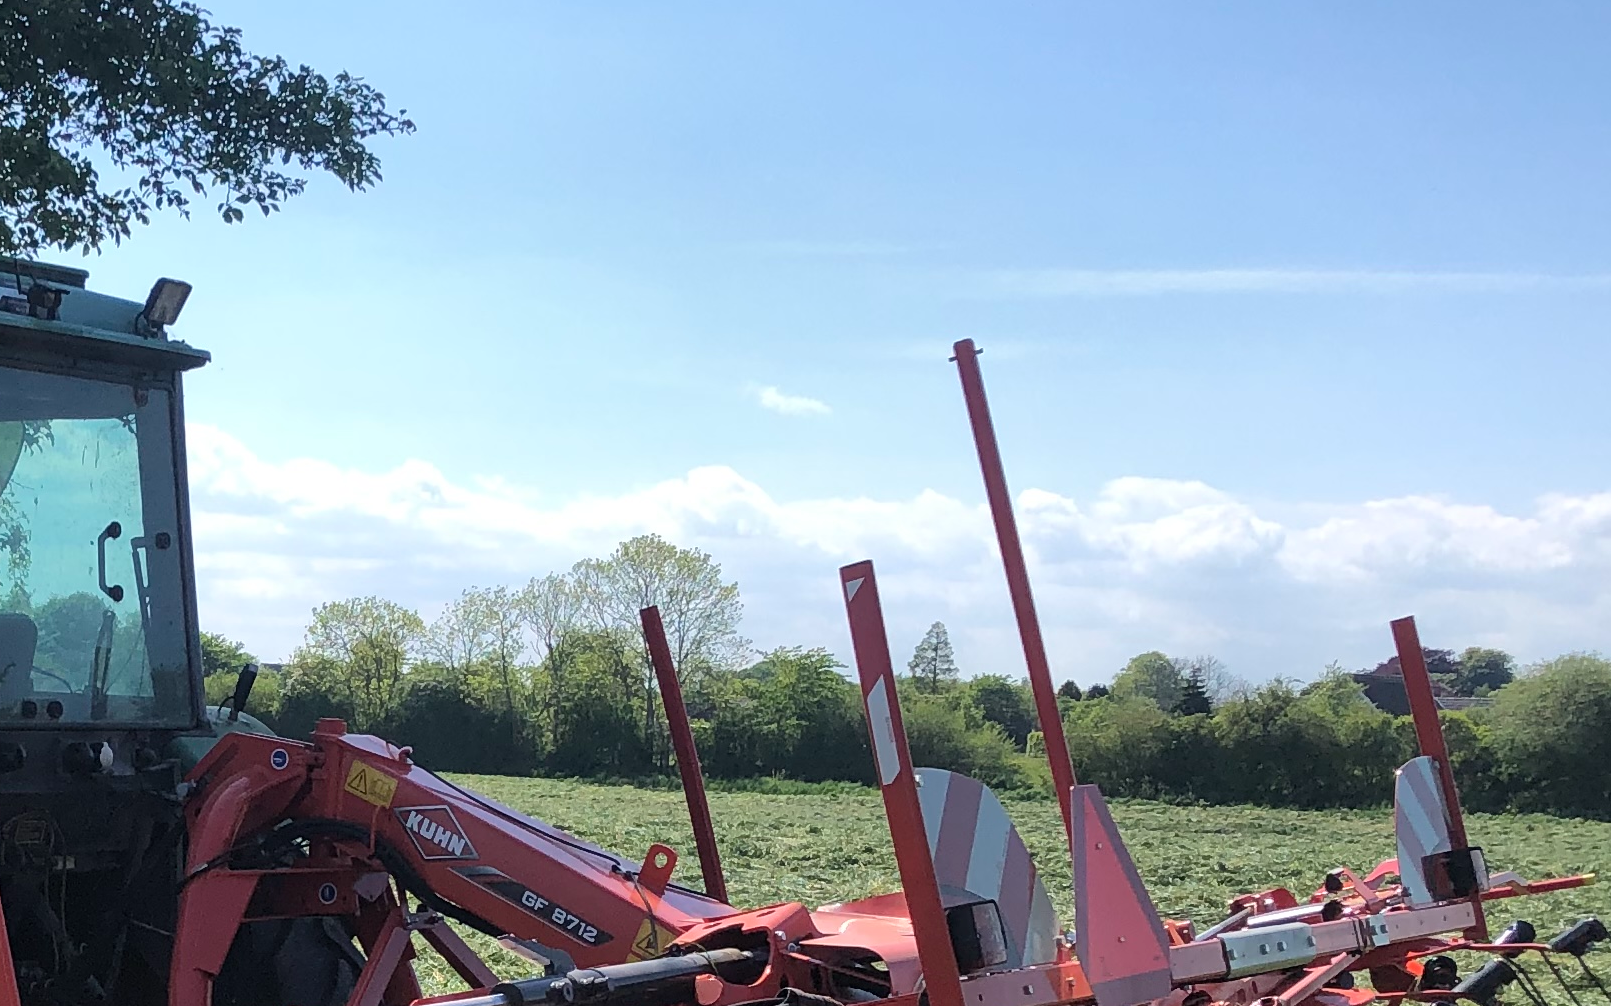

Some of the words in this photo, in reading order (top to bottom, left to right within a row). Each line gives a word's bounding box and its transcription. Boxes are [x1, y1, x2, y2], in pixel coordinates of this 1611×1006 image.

[405, 810, 466, 857] KUHN
[521, 890, 549, 911] GF
[551, 907, 598, 943] 8712
